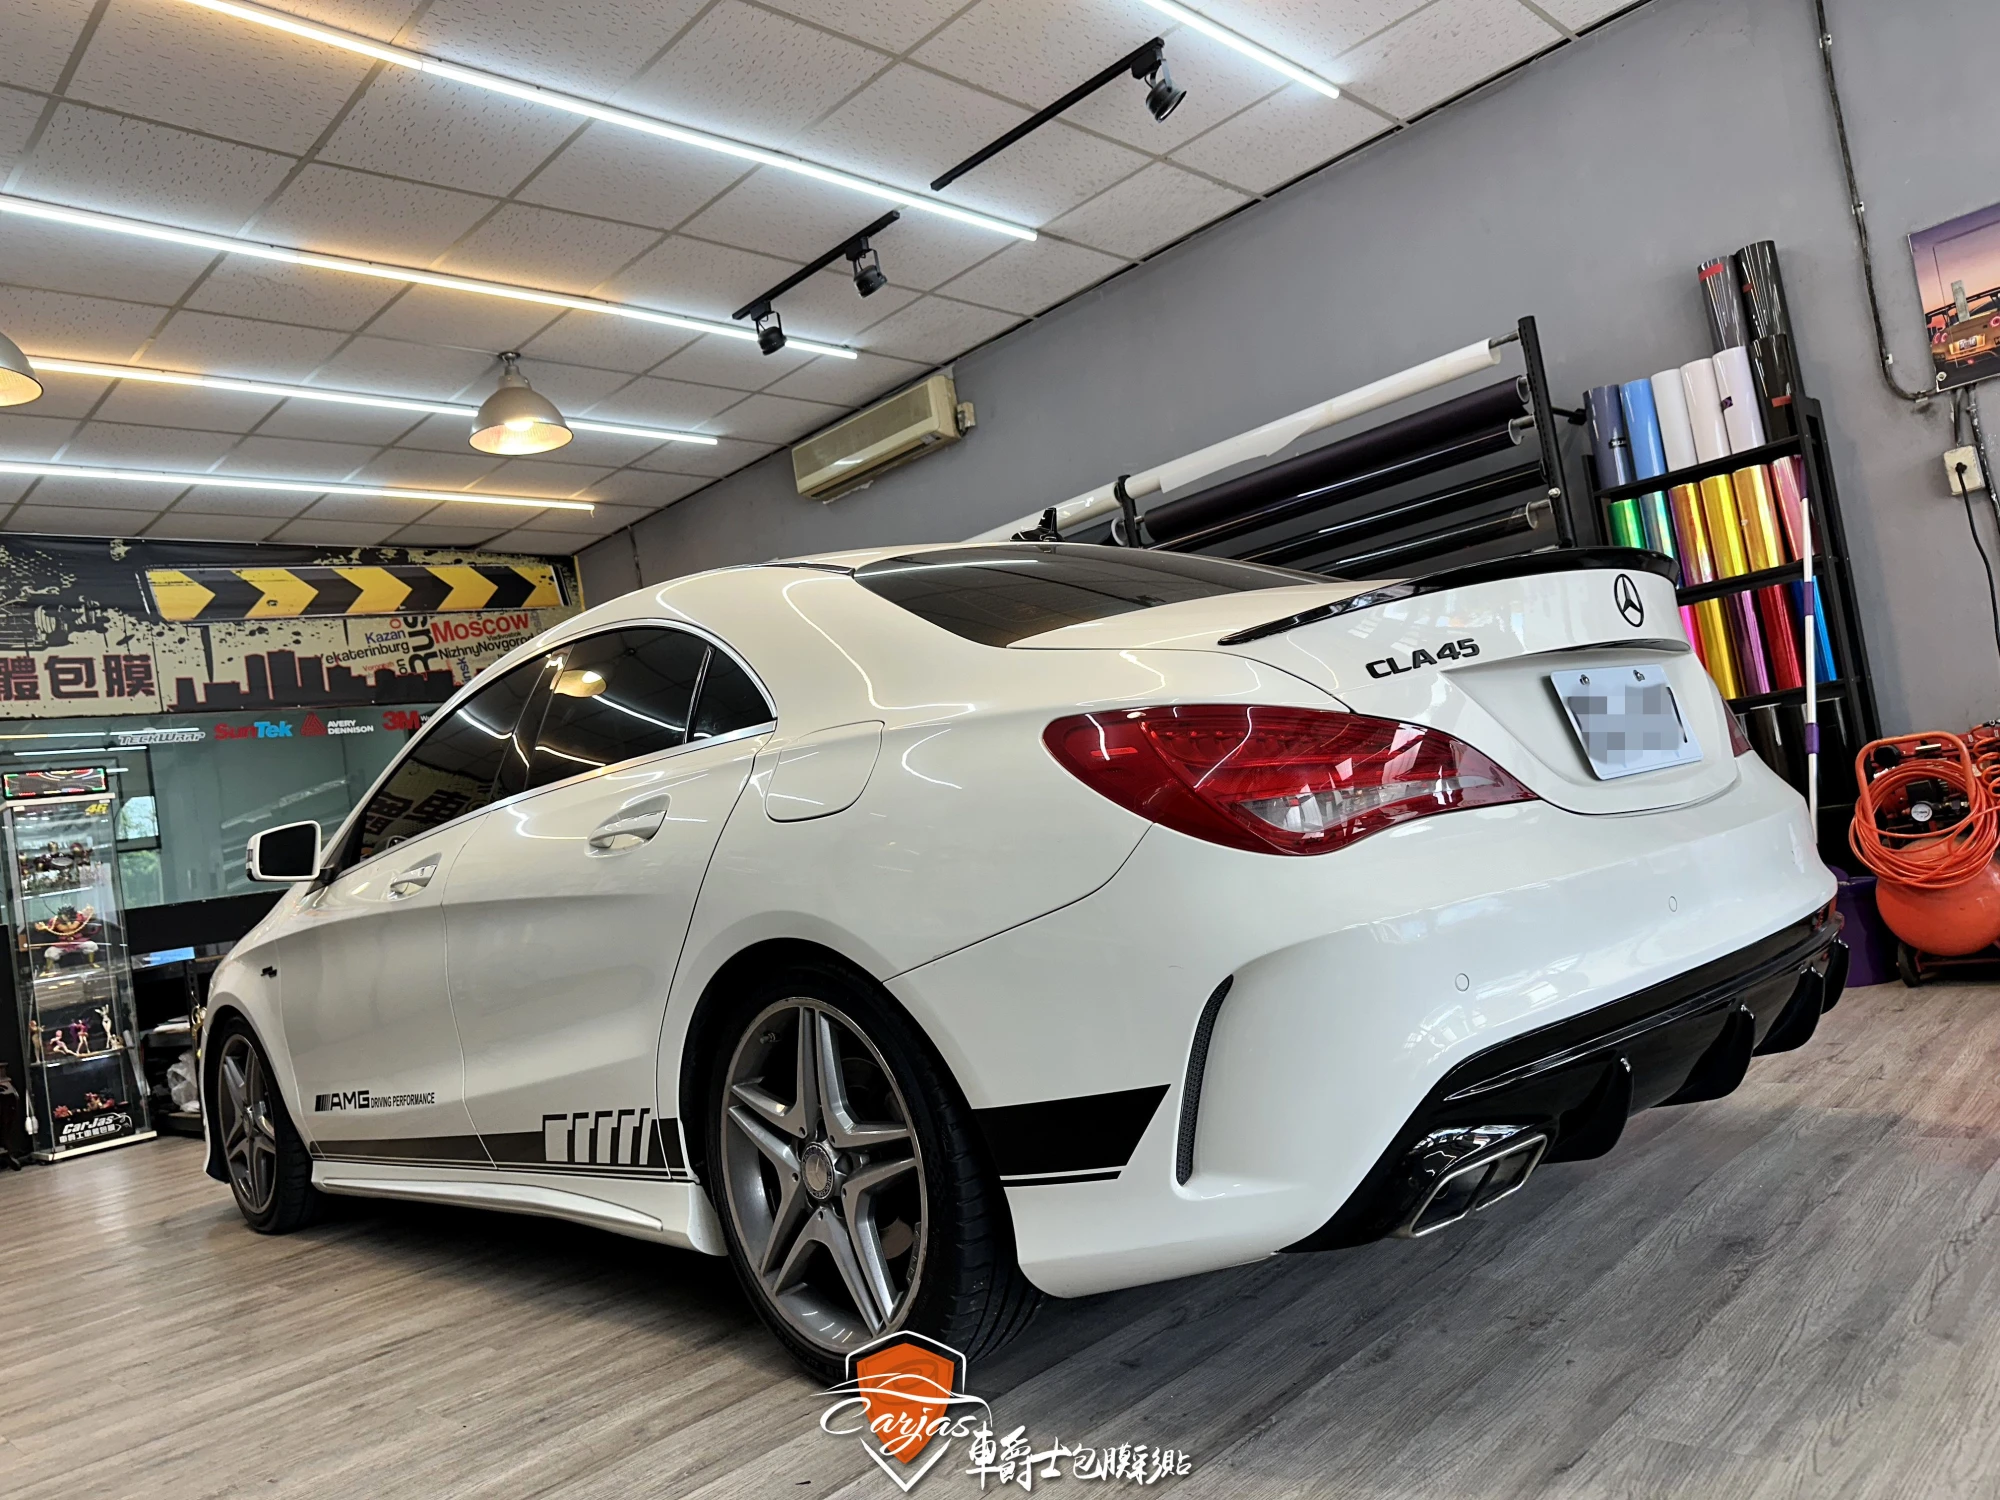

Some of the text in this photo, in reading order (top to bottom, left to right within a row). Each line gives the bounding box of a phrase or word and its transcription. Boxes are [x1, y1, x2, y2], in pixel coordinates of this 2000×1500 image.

[365, 630, 406, 645] Kazan
[327, 719, 357, 728] AVERY
[383, 710, 420, 731] 3M
[214, 721, 293, 740] SunTek
[327, 725, 375, 735] DENNISON
[329, 1090, 435, 1111] AMG DRIVING PERFORMANCE
